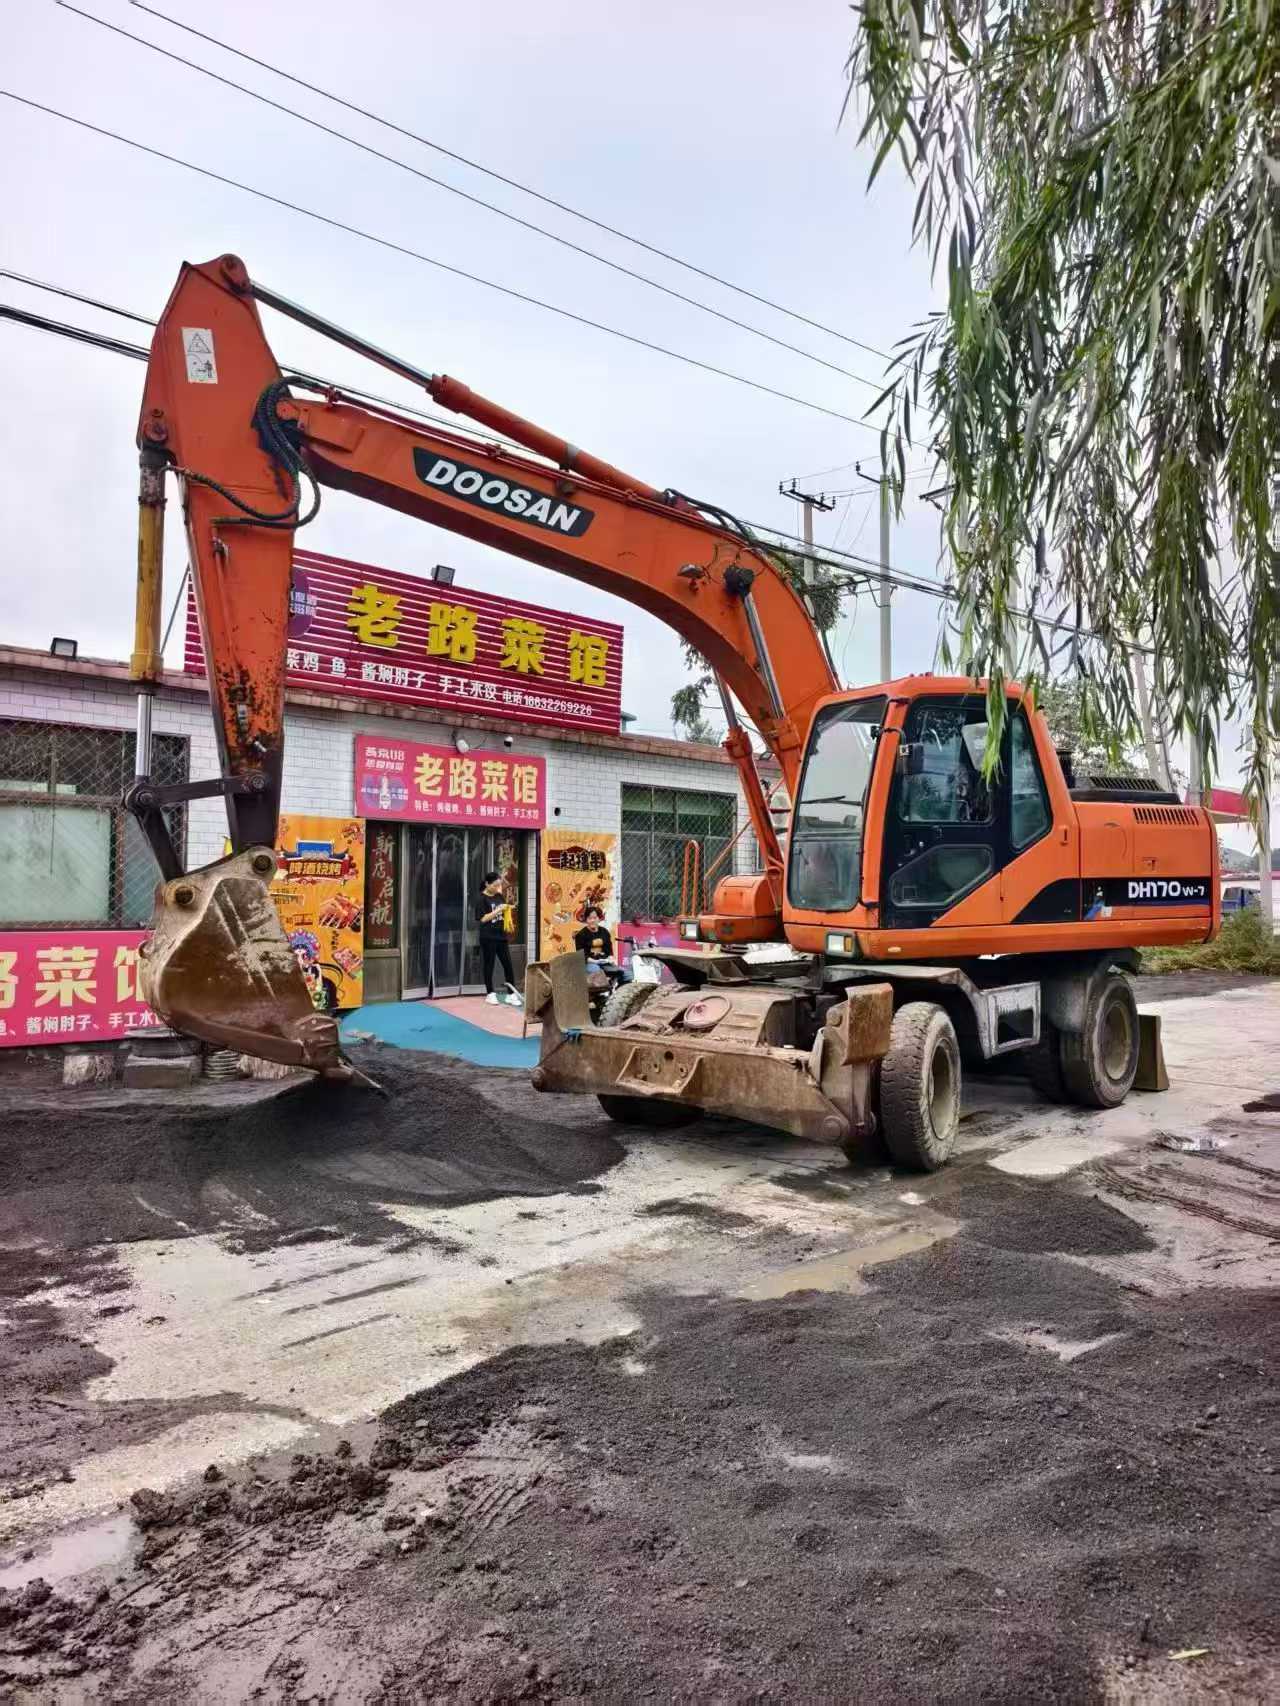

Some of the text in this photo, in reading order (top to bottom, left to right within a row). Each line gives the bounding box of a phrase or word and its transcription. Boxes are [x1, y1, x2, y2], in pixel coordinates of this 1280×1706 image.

[425, 459, 581, 531] DOOSAN
[347, 584, 609, 687] 老路菜馆
[331, 656, 347, 678] 鱼
[438, 675, 497, 701] 手工水饺
[414, 752, 539, 804] 老路菜馆
[1128, 880, 1180, 898] DH170
